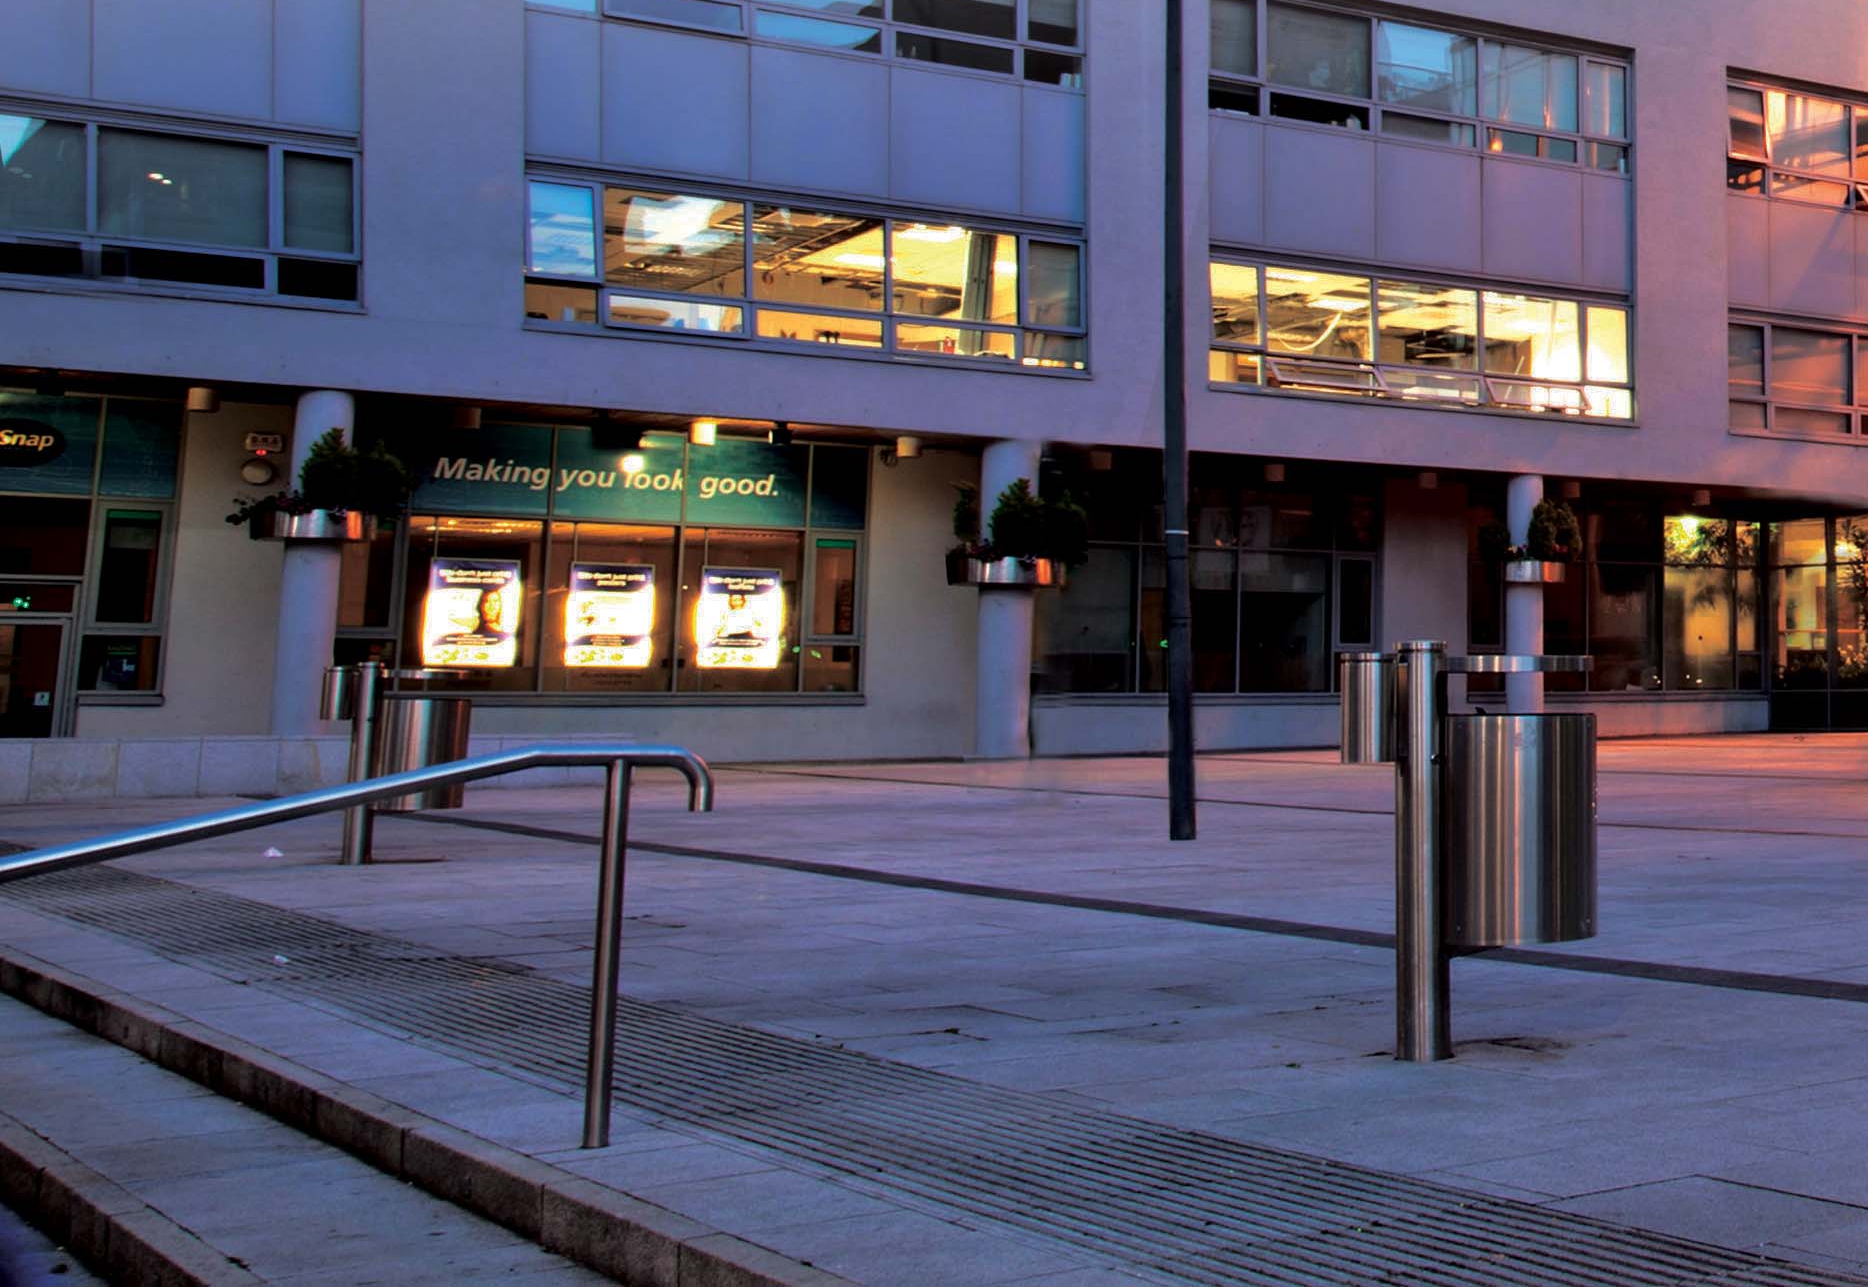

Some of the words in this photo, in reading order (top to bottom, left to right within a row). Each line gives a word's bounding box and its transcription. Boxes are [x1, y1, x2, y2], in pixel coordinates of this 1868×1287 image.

[0, 429, 55, 452] Snap
[433, 457, 551, 491] Making
[556, 468, 617, 492] you
[624, 467, 684, 491] look
[699, 474, 779, 499] good.
